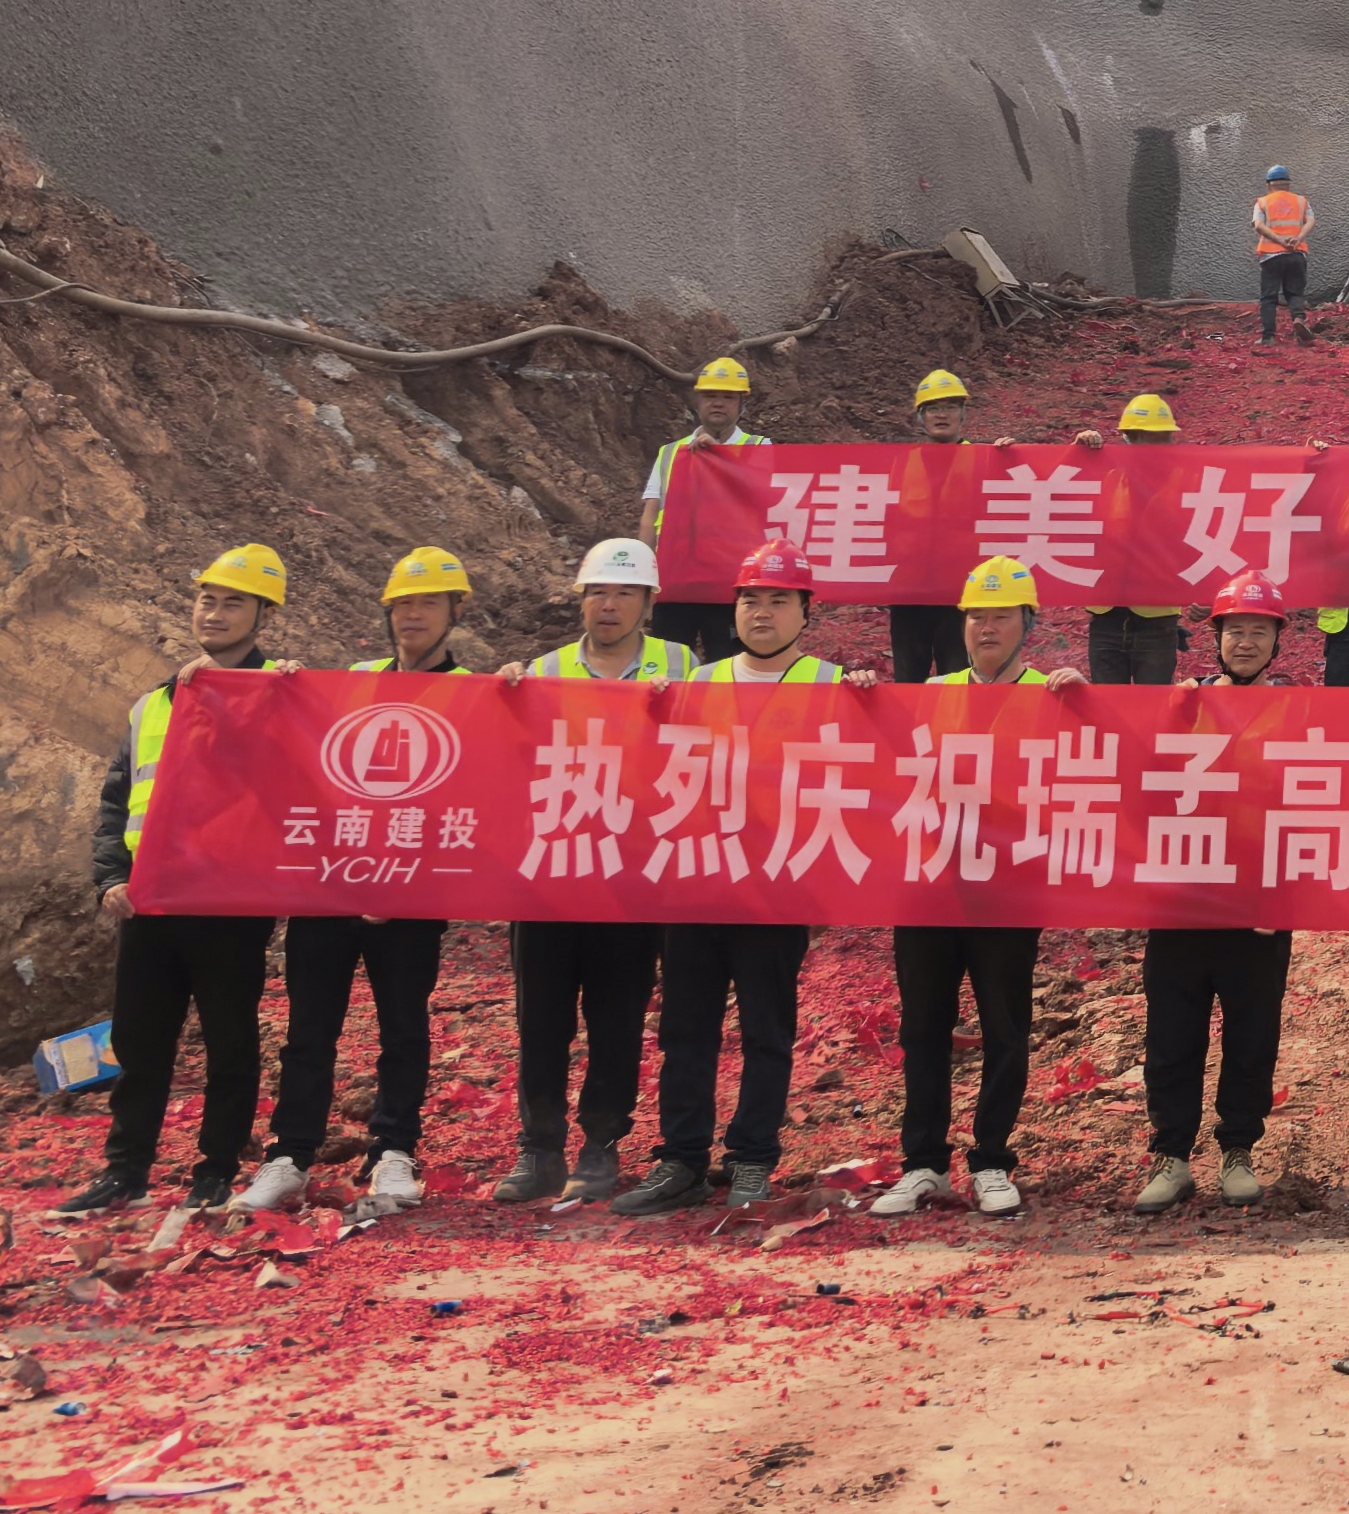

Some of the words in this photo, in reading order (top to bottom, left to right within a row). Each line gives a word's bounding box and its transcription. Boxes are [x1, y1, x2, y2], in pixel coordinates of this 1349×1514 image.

[283, 805, 479, 851] 云南建投
[318, 856, 423, 885] YCIH
